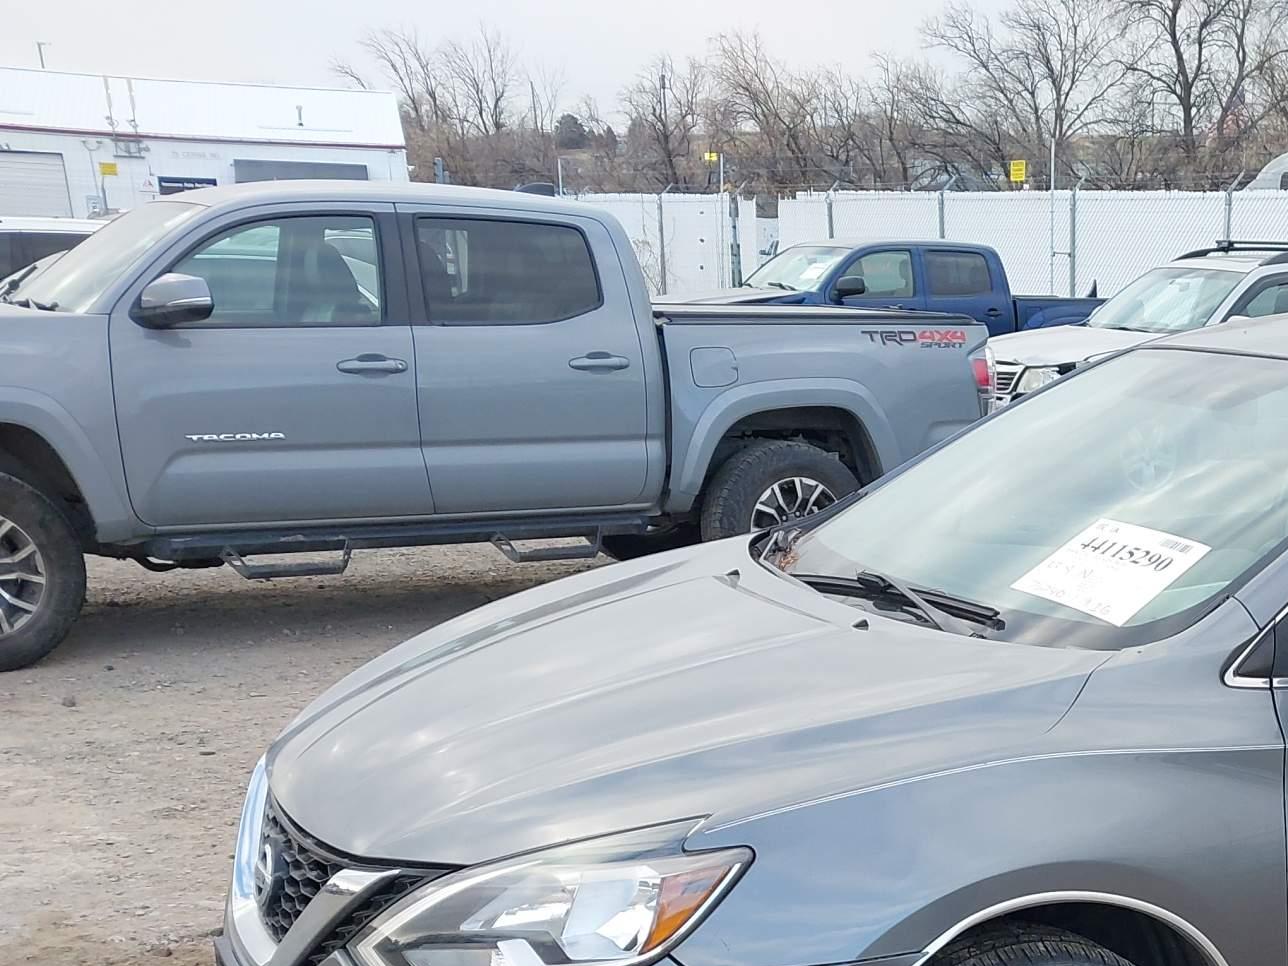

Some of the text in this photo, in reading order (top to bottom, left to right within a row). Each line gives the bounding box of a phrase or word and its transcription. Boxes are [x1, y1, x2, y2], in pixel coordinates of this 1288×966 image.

[861, 330, 917, 346] TRD
[920, 341, 963, 349] SPORT
[184, 432, 286, 442] TACOMA
[1080, 536, 1174, 572] 44115290
